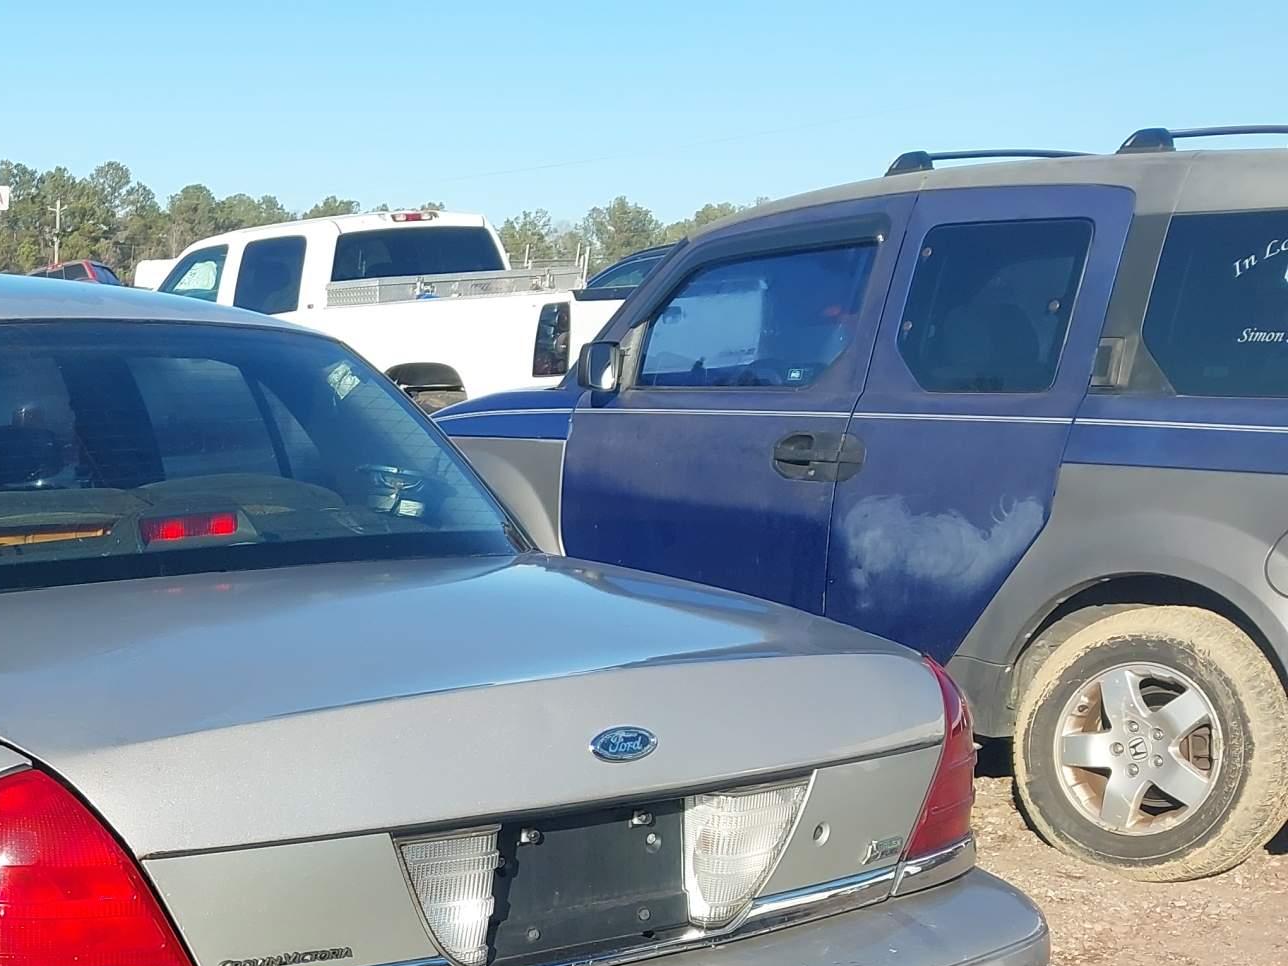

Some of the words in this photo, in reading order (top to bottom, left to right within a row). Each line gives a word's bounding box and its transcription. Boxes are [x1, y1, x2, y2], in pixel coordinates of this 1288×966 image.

[1233, 254, 1258, 278] In
[1237, 327, 1285, 343] Simon
[609, 732, 643, 753] Ford
